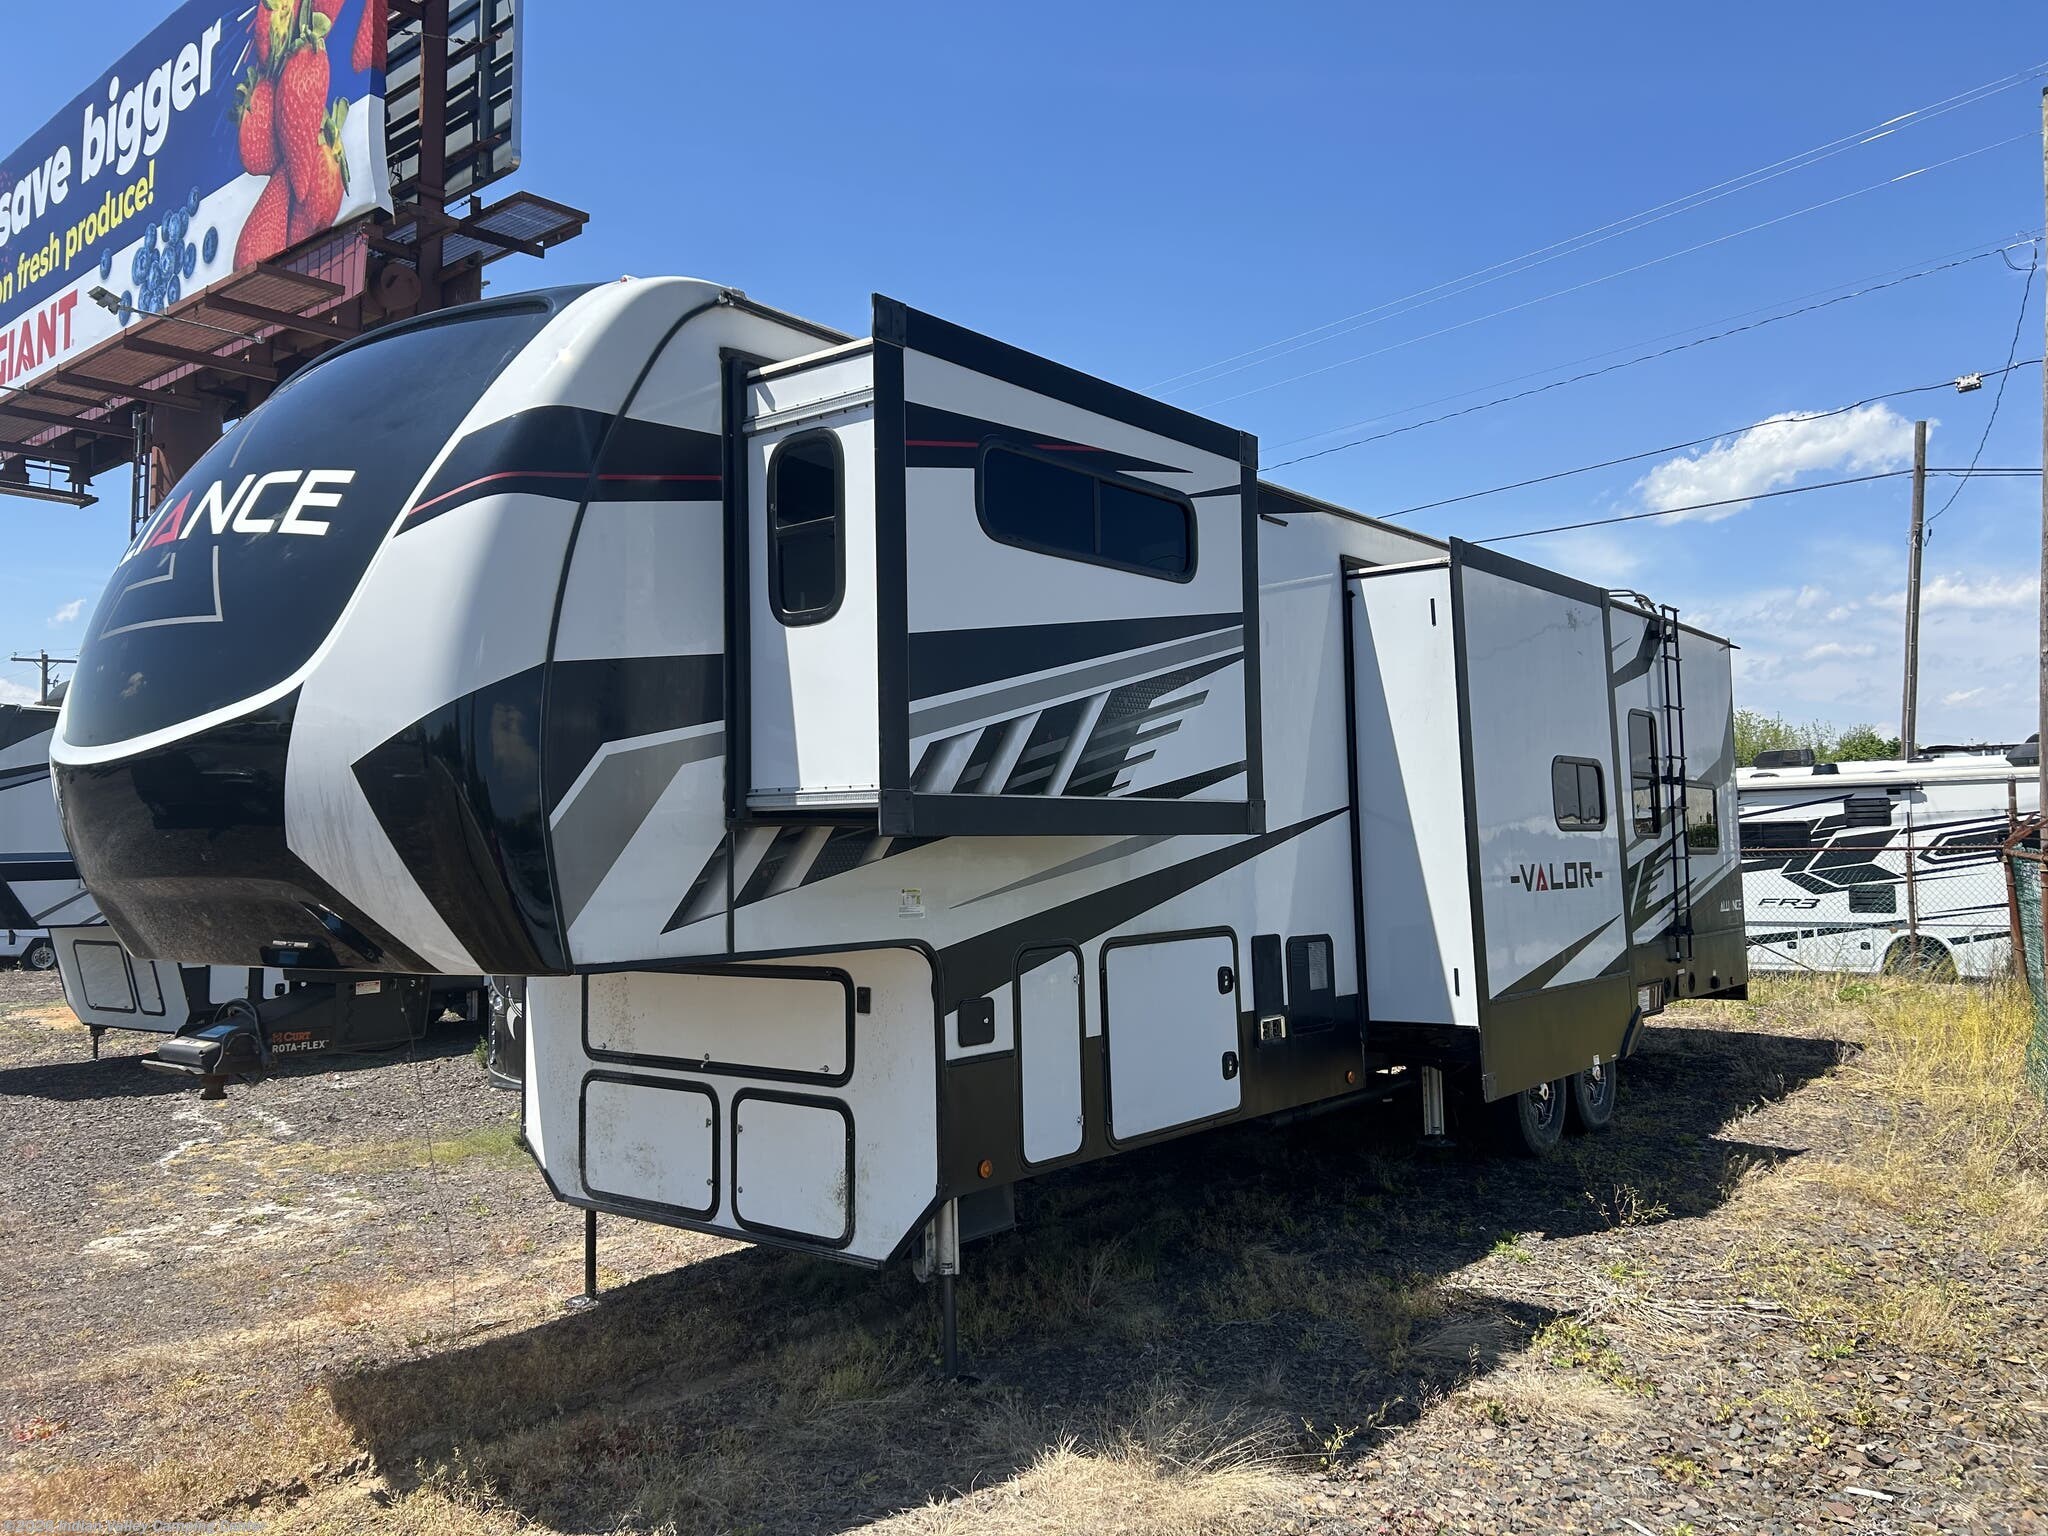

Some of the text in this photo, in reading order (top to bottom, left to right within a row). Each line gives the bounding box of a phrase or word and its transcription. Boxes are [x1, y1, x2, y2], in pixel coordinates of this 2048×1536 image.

[0, 18, 222, 248] save bigger
[17, 231, 60, 293] fresh
[65, 158, 155, 272] produce!
[1758, 897, 1821, 909] FR3
